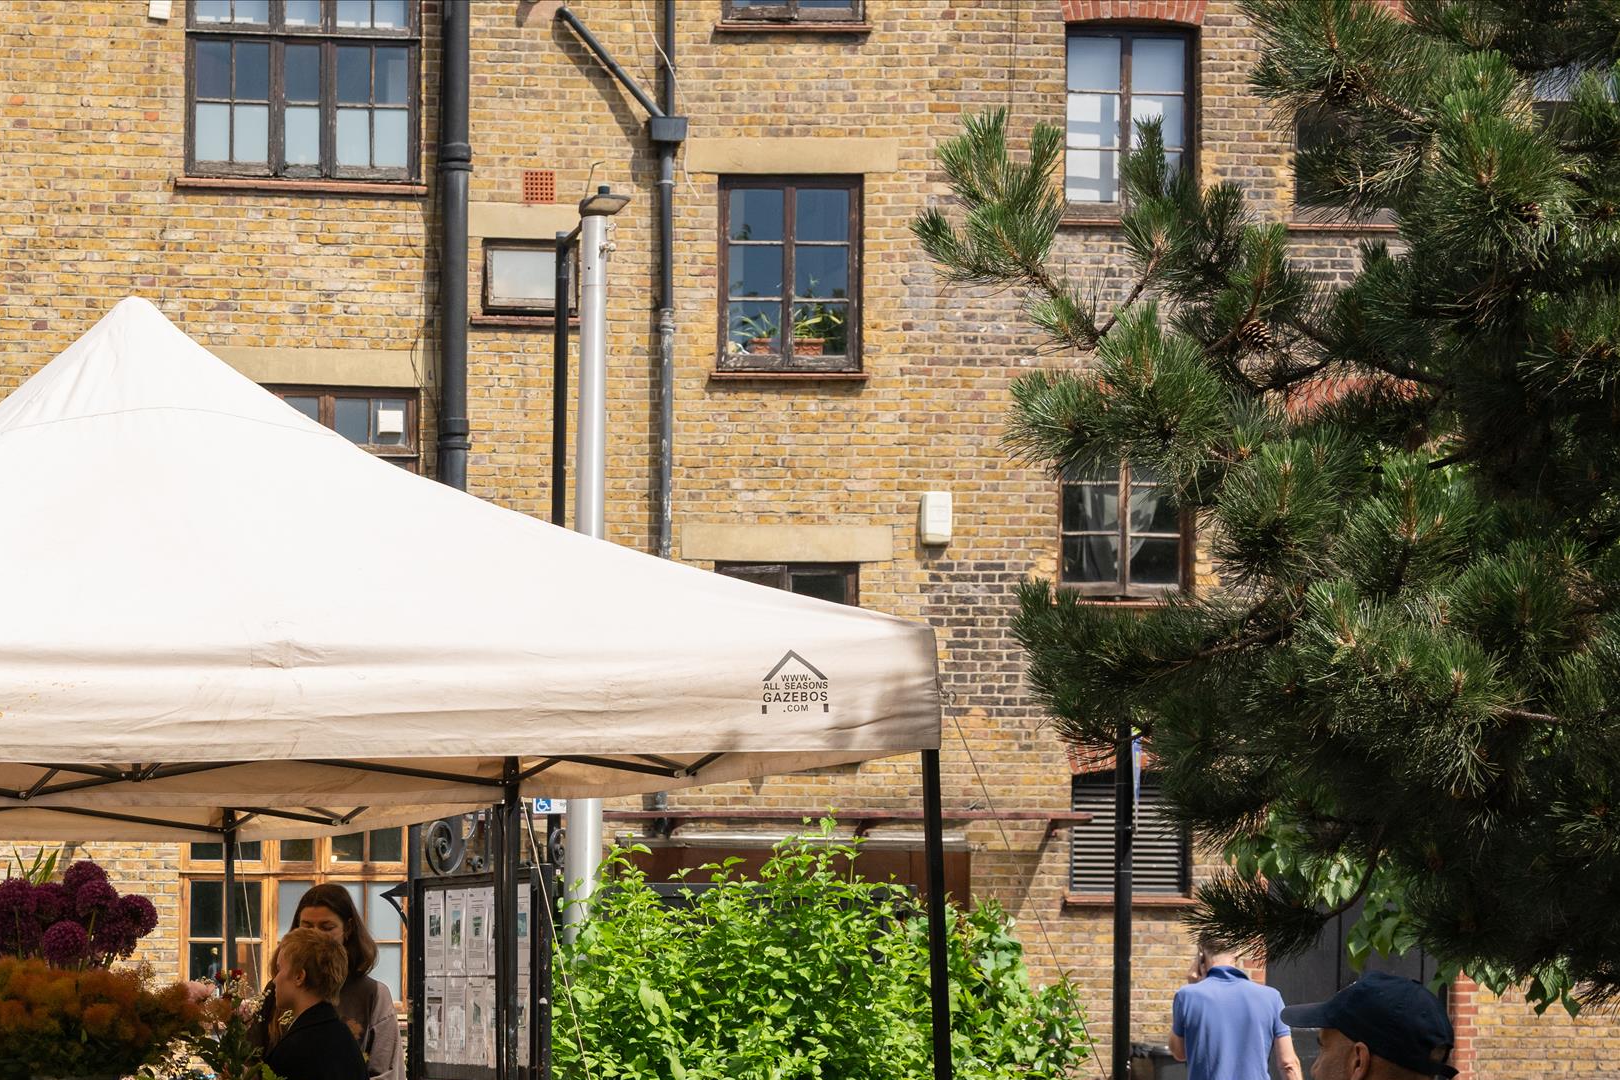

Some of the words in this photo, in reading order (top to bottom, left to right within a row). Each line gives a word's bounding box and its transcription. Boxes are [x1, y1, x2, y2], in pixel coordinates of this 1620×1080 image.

[780, 673, 811, 682] WWW.
[763, 682, 781, 691] ALL
[784, 681, 829, 690] SEASONS
[762, 691, 828, 703] GAZEBOS
[782, 704, 809, 713] .COM
